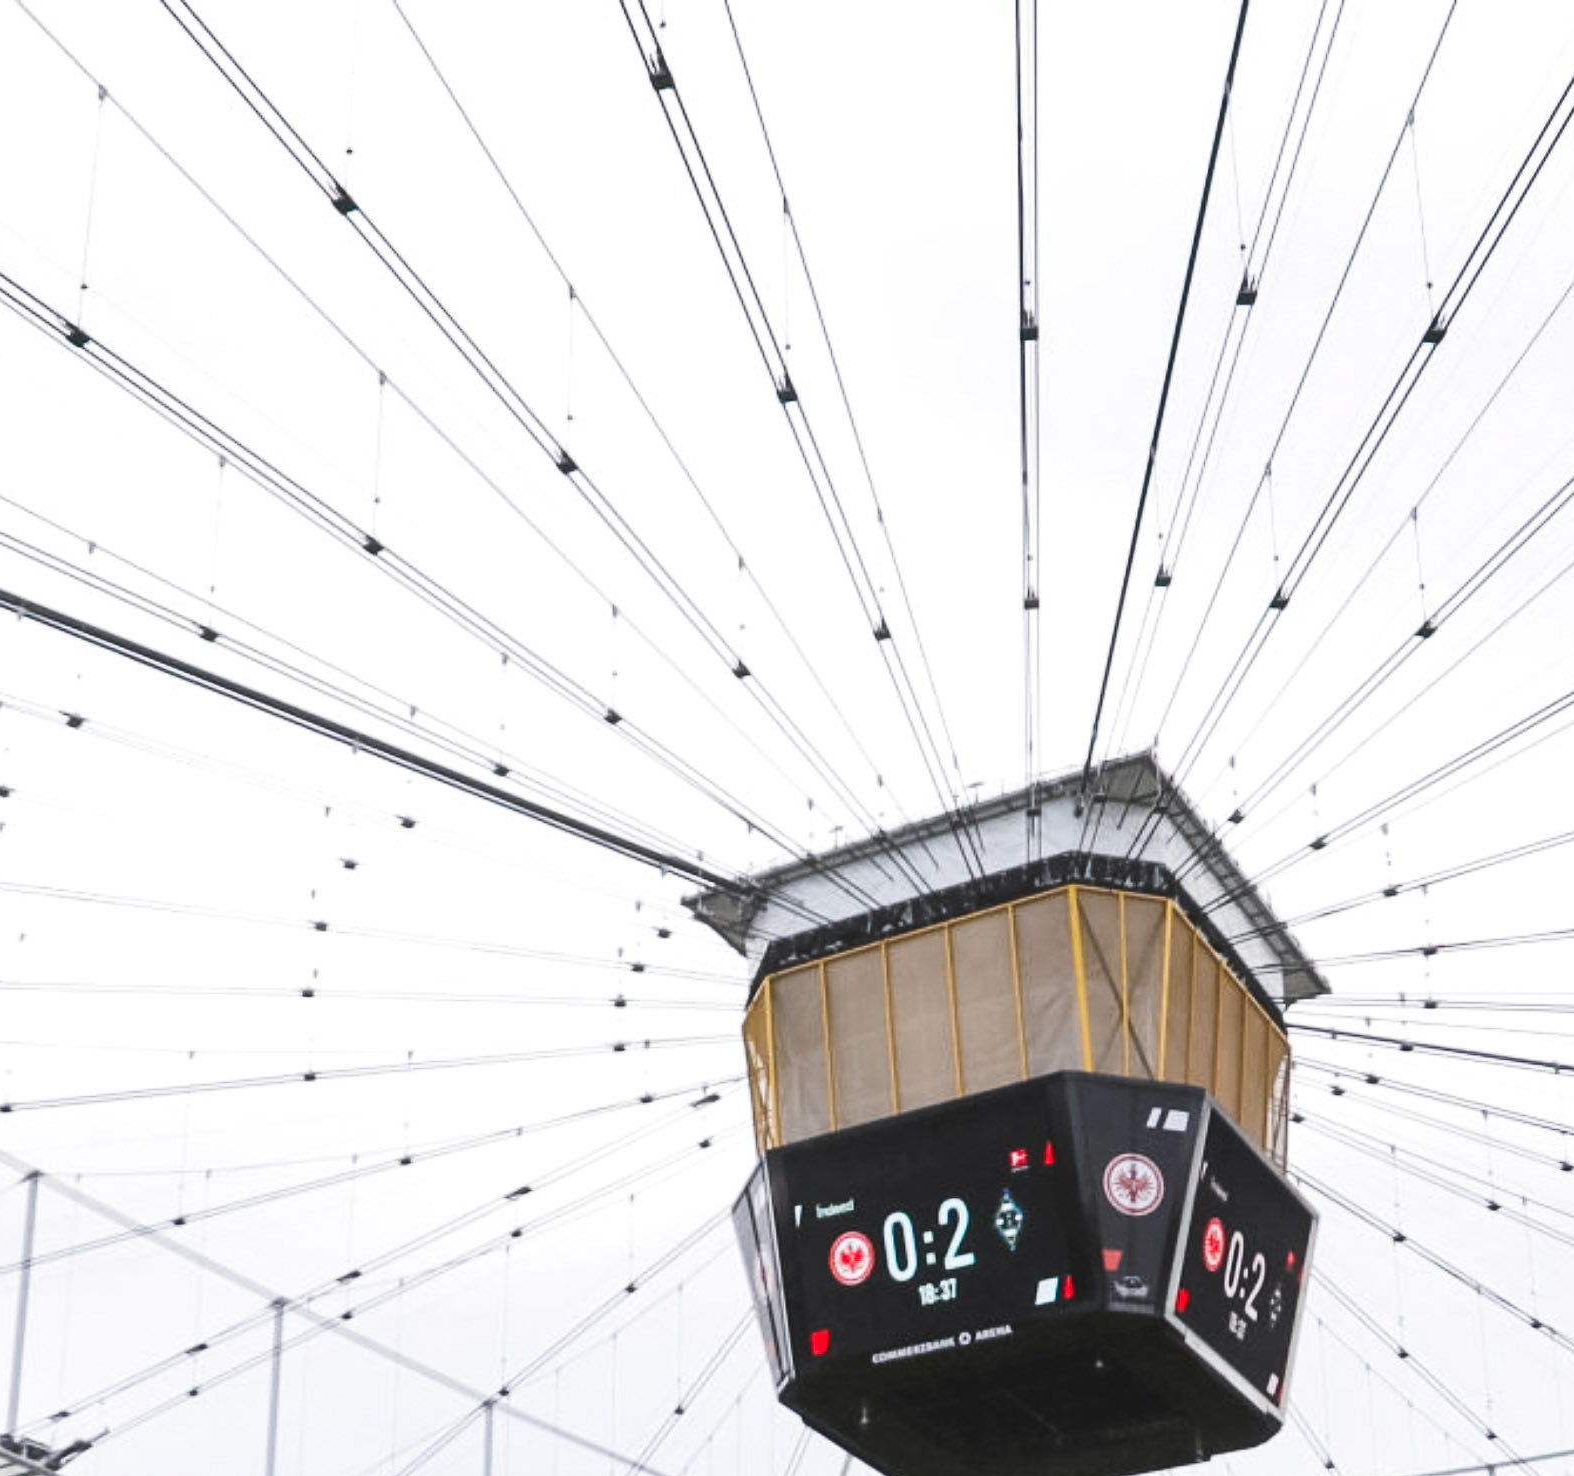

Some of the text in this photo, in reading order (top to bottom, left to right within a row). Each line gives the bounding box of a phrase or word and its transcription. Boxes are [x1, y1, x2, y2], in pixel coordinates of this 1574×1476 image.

[883, 1197, 976, 1282] 0:2
[1224, 1231, 1266, 1322] 0:2
[975, 1324, 1013, 1341] ARENA
